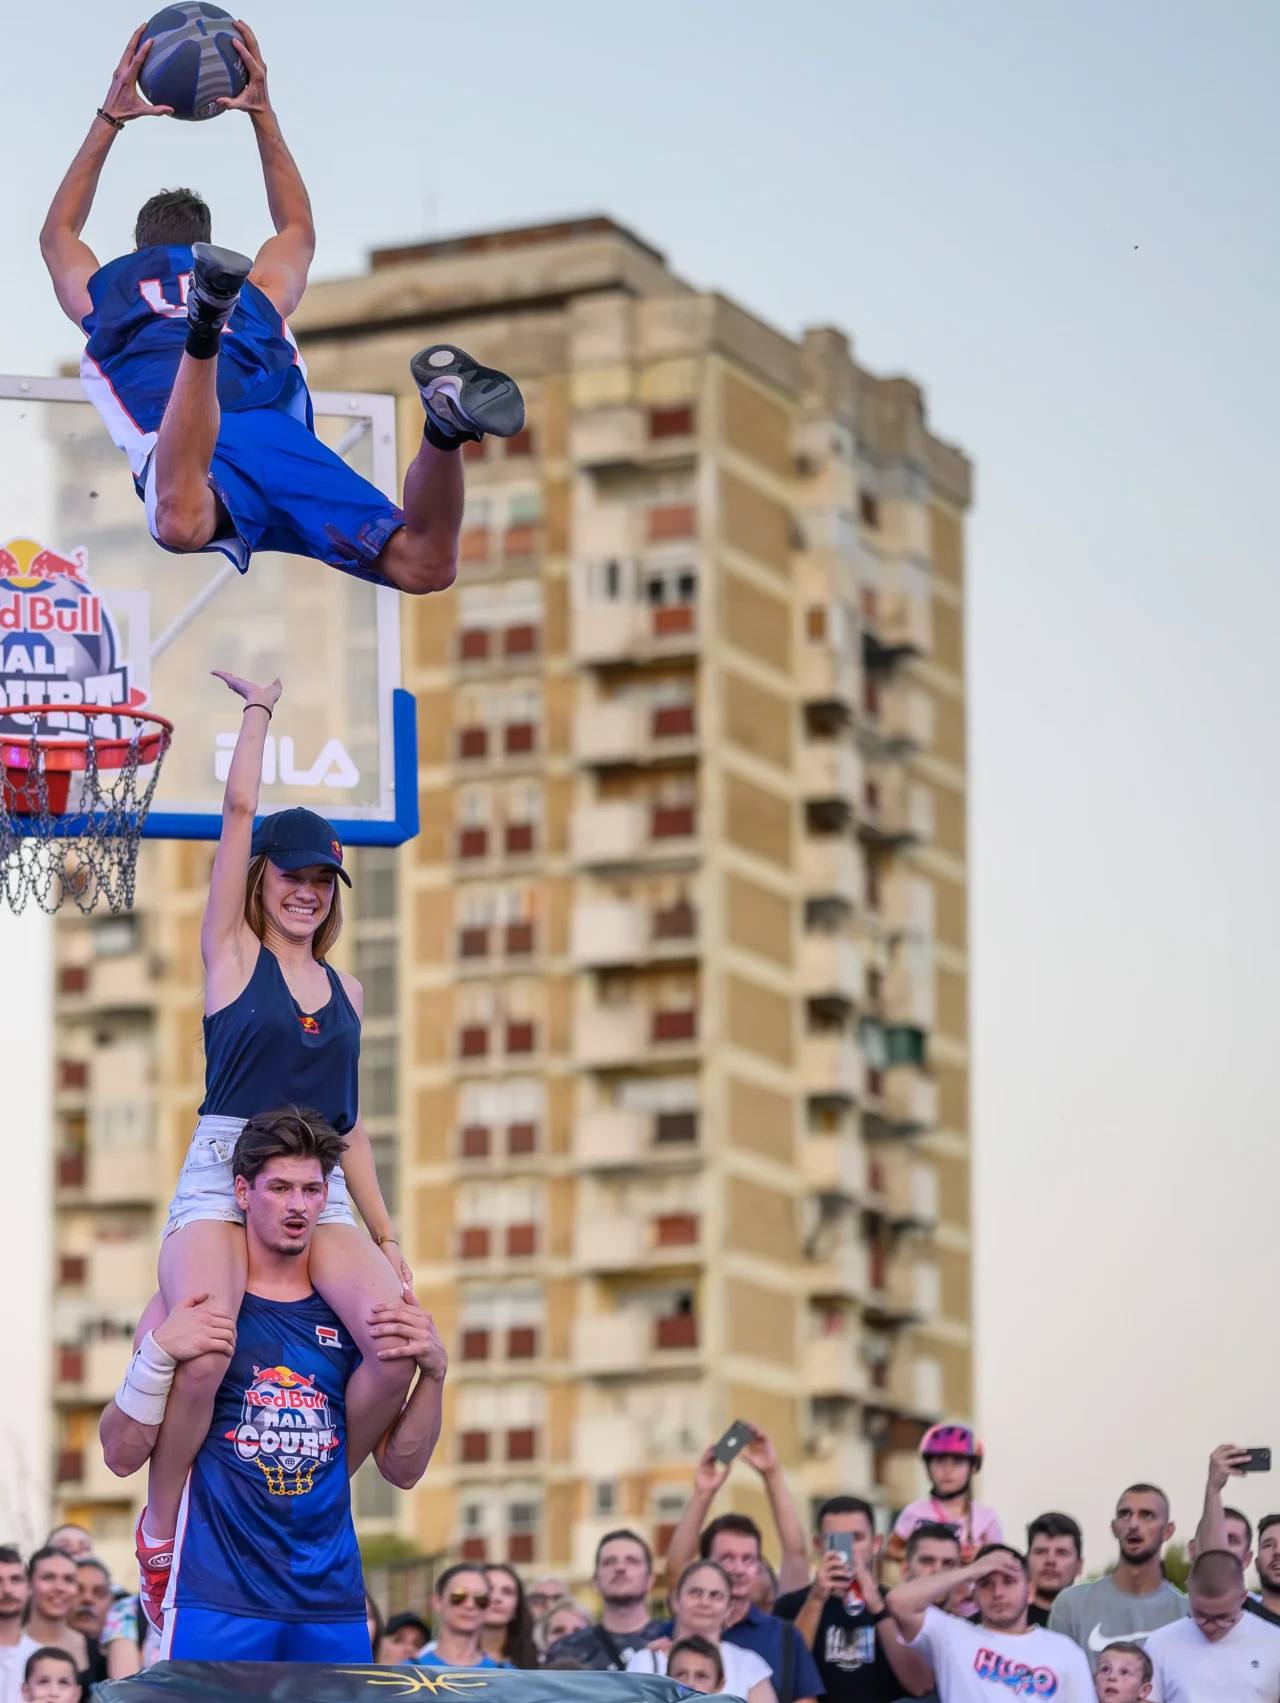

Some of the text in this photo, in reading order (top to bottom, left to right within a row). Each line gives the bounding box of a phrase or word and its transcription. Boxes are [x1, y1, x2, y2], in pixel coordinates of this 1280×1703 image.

[29, 597, 100, 632] Bull
[246, 1389, 326, 1409] Red Bull
[264, 1411, 314, 1429] HALF
[236, 1424, 333, 1463] COURT
